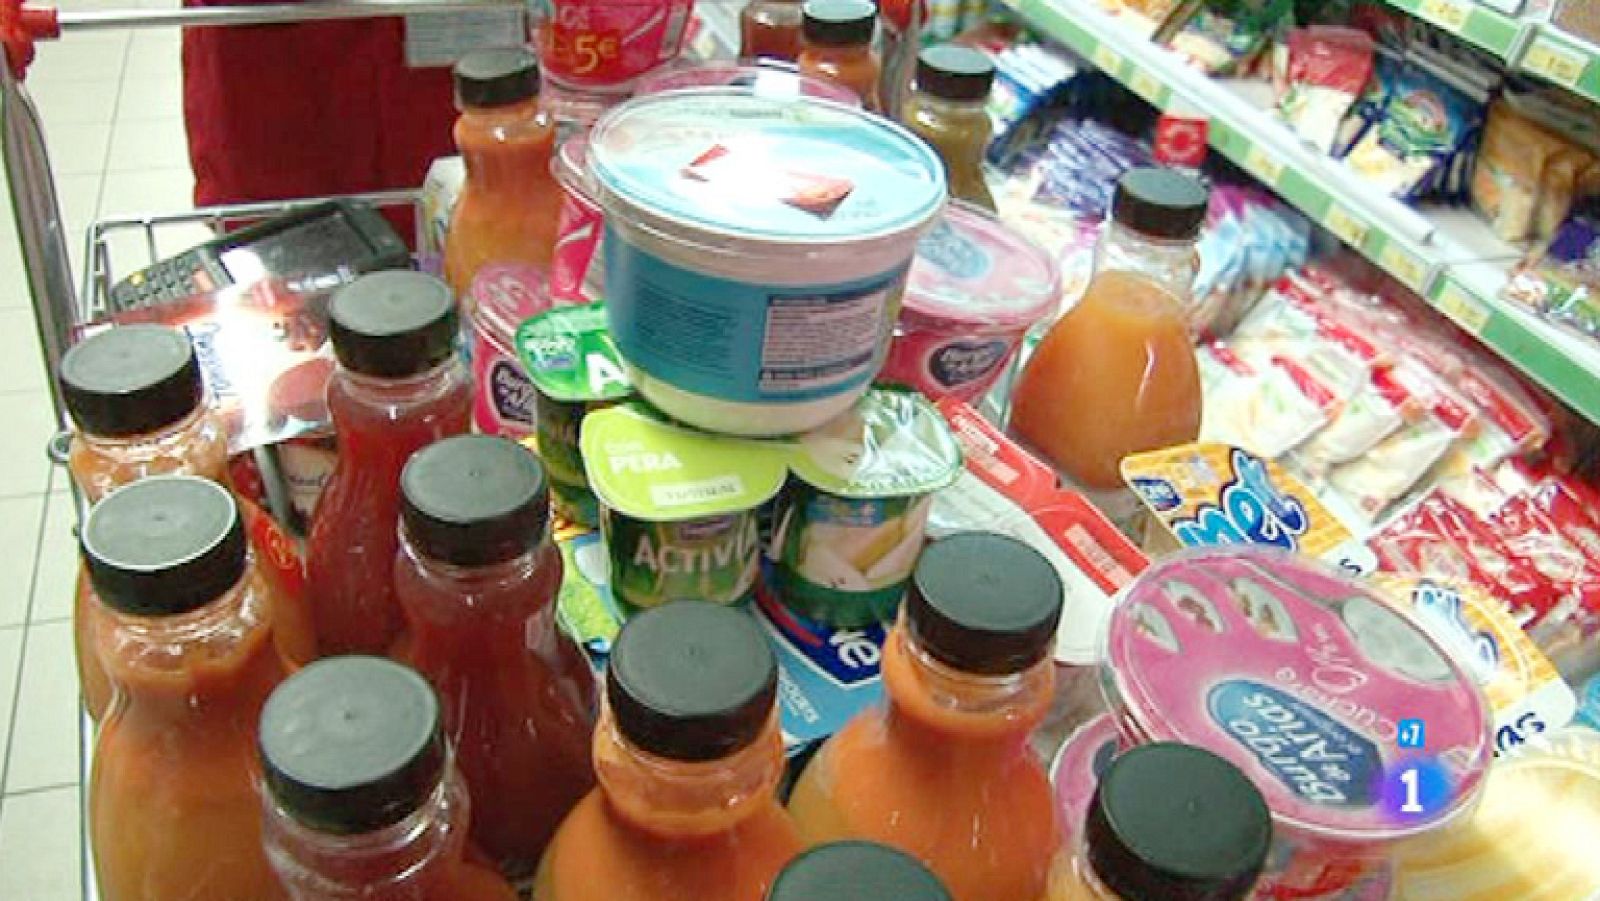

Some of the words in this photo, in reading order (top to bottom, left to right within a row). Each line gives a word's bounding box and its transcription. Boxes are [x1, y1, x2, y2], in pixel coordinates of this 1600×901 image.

[608, 452, 683, 475] PERA
[1228, 718, 1348, 802] Burgo
[1242, 692, 1348, 763] Arias
